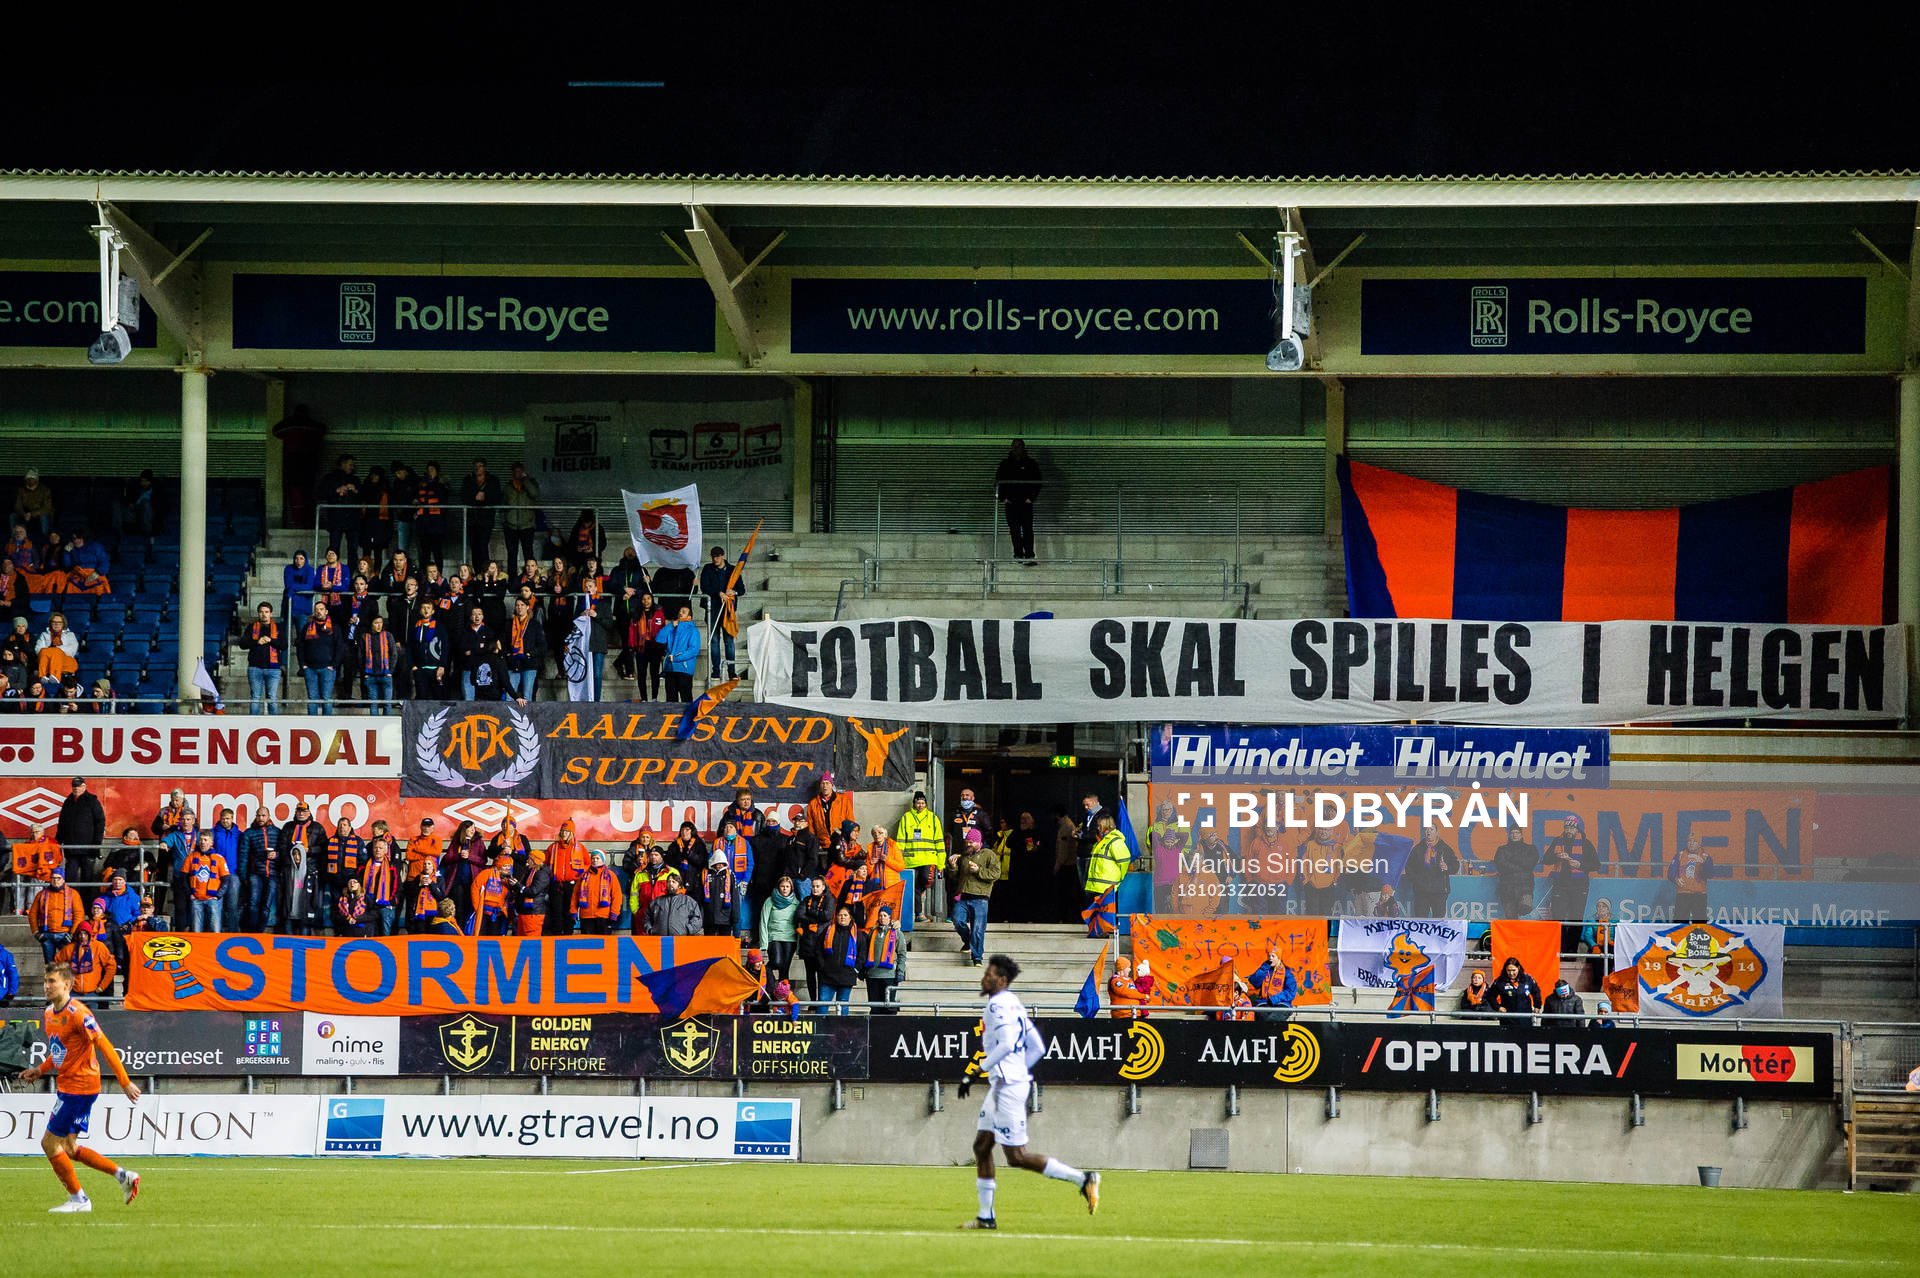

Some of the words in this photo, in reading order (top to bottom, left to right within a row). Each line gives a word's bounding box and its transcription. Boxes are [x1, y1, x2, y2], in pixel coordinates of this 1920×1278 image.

[395, 296, 609, 341] Rolls-Royce
[847, 299, 1219, 339] www.rolls-royce.com
[1528, 297, 1752, 343] Rolls-Royce
[790, 619, 1042, 701] FOTBALL
[1089, 619, 1246, 700] SKAL
[1290, 620, 1532, 706] SPILLES
[1582, 624, 1601, 705] I
[1647, 624, 1886, 712] HELGEN
[546, 712, 833, 745] AALESUND
[52, 727, 391, 765] BUSENGDAL
[559, 757, 815, 789] SUPPORT
[212, 936, 676, 1006] STORMEN
[1644, 962, 1661, 971] 19
[1738, 962, 1756, 971] 14
[531, 1017, 592, 1032] GOLDEN
[753, 1020, 814, 1035] GOLDEN
[332, 1036, 384, 1053] nime
[531, 1037, 591, 1052] ENERGY
[753, 1040, 811, 1055] ENERGY
[890, 1031, 969, 1062] AMFI
[1043, 1033, 1122, 1062] AMFI
[1198, 1035, 1277, 1065] AMFI
[236, 1057, 275, 1065] BERGERSEN
[276, 1057, 290, 1065] FLIS
[315, 1057, 344, 1067] maling
[350, 1057, 367, 1067] gulv
[372, 1057, 385, 1066] flis
[530, 1057, 607, 1072] OFFSHORE
[752, 1060, 829, 1075] OFFSHORE
[1385, 1040, 1613, 1076] OPTIMERA
[1700, 1051, 1792, 1076] Montér
[333, 1103, 347, 1118] G
[741, 1106, 756, 1121] G
[104, 1106, 258, 1141] UNION
[402, 1105, 720, 1146] www.gtravel.no
[739, 1146, 786, 1154] TRAVEL
